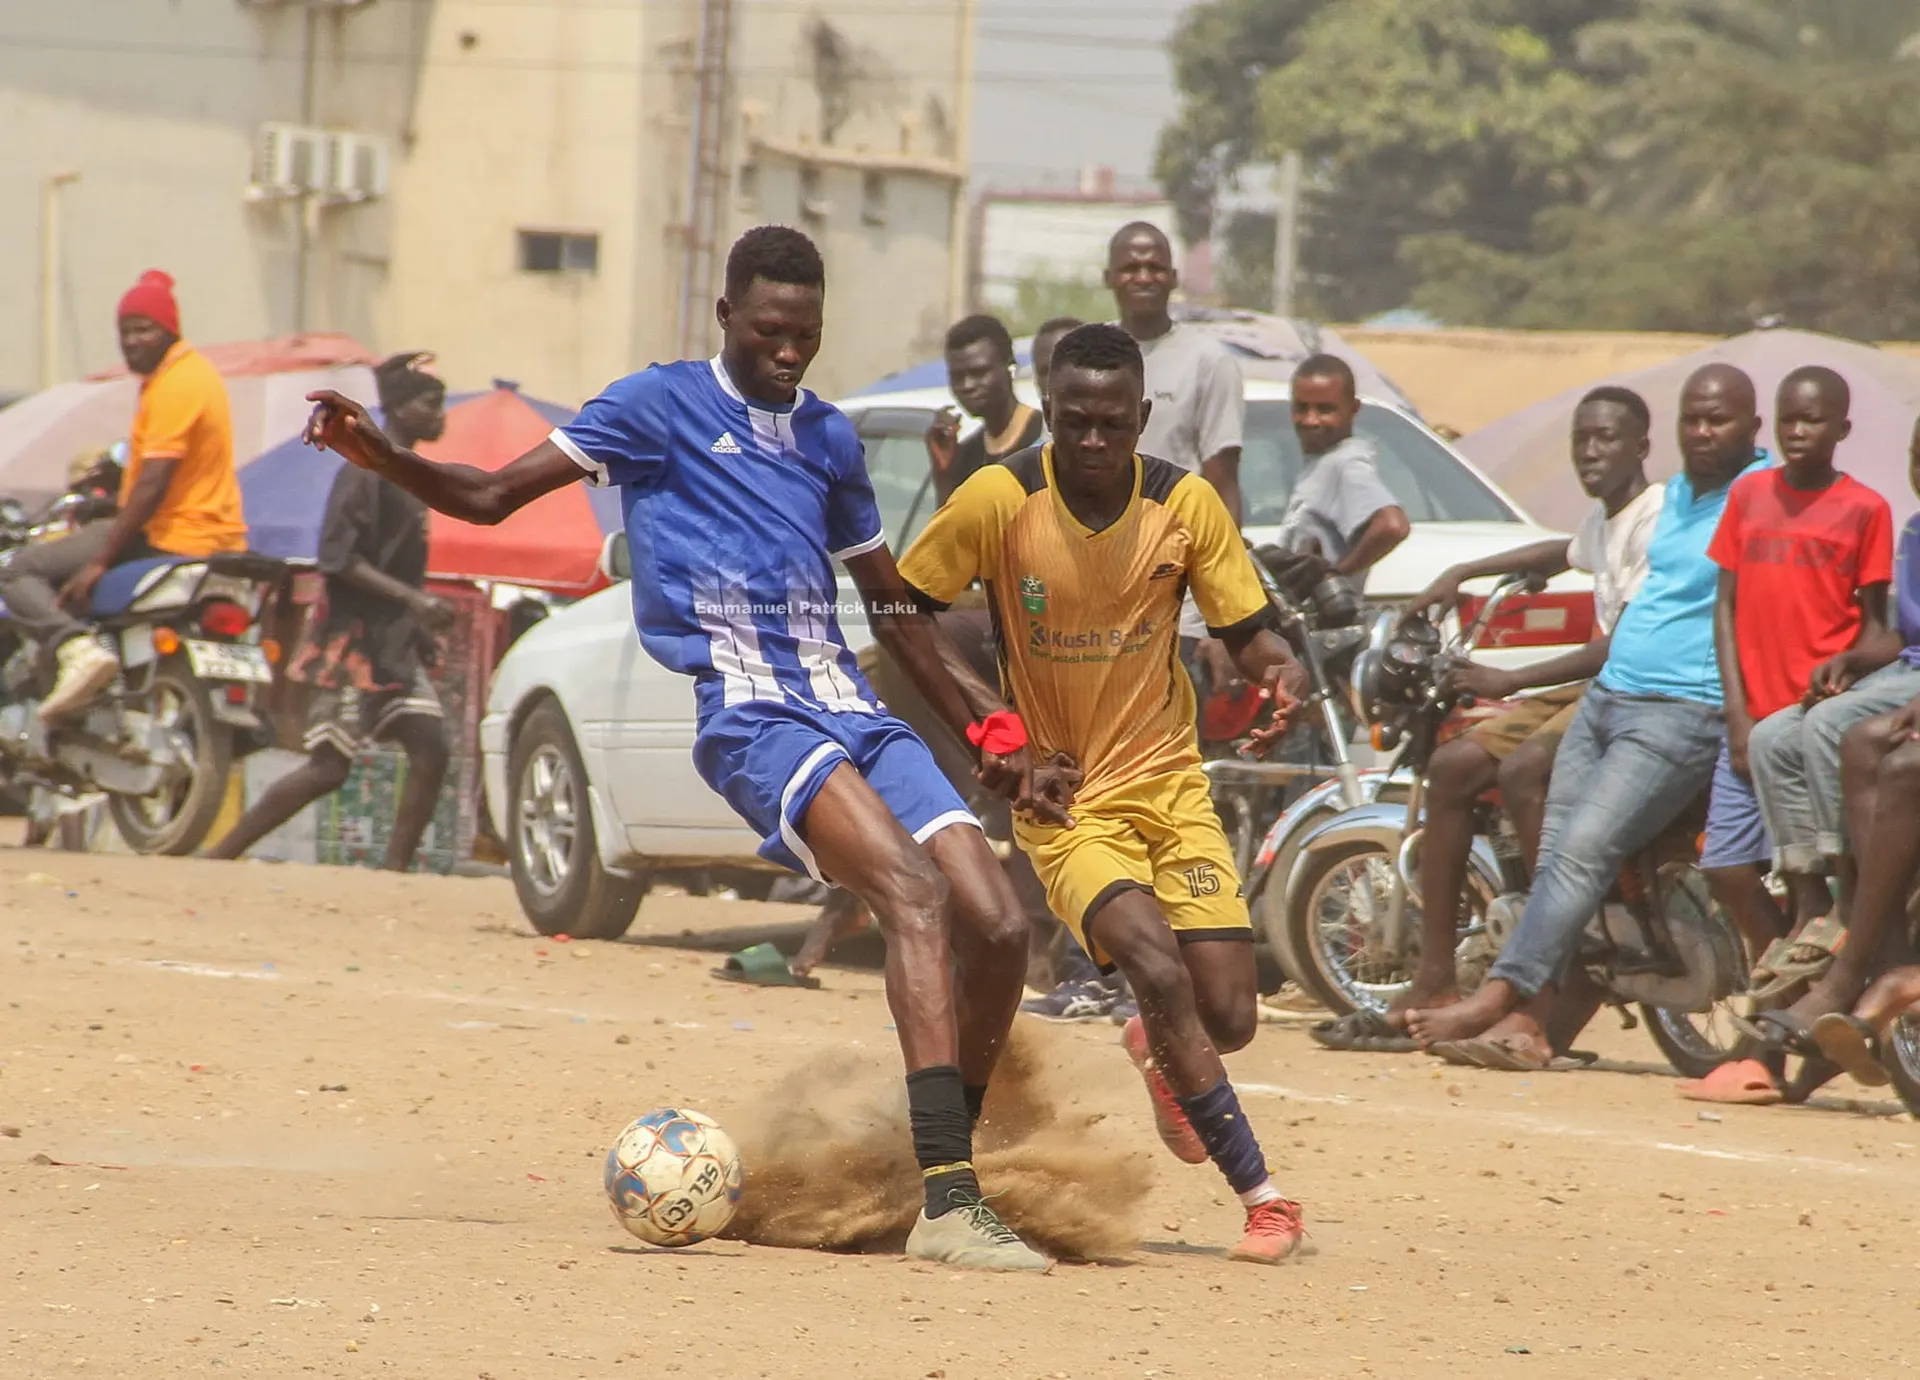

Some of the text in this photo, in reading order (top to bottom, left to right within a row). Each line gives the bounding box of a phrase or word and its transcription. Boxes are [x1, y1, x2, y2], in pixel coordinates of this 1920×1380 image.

[1051, 617, 1152, 649] Kush Bk
[1183, 863, 1220, 898] 15
